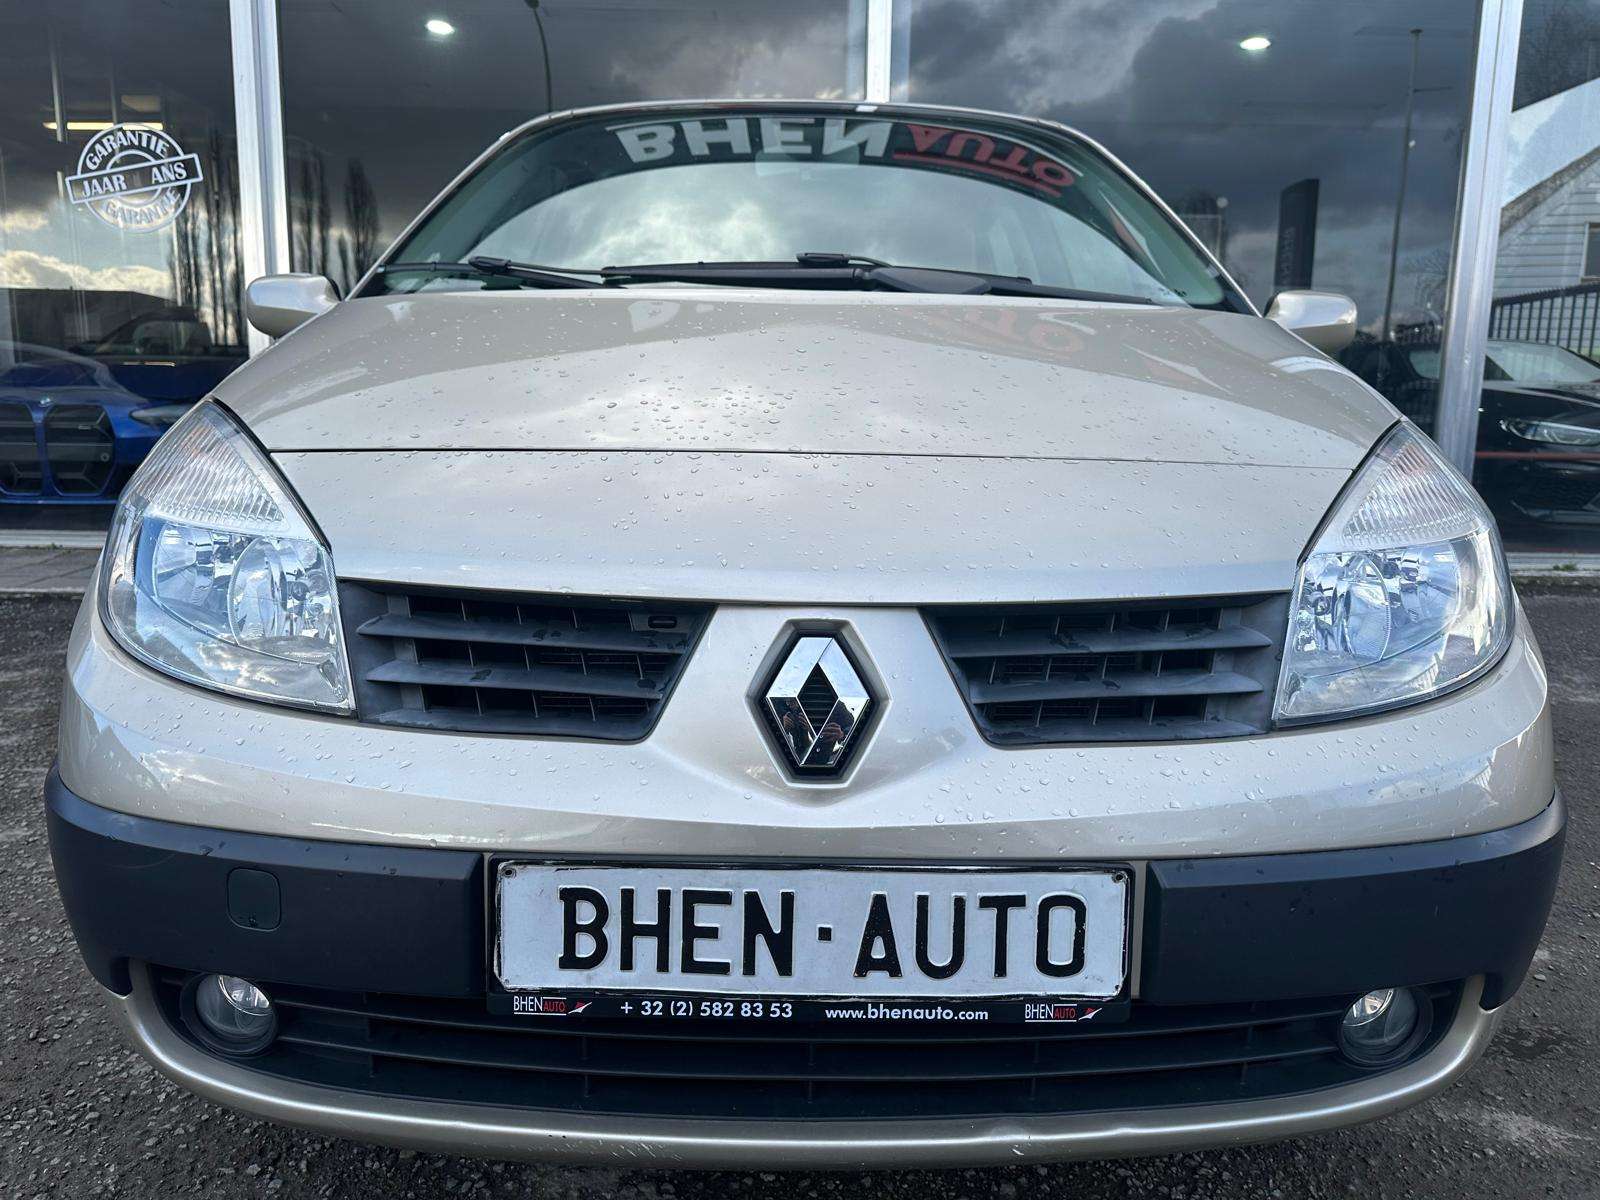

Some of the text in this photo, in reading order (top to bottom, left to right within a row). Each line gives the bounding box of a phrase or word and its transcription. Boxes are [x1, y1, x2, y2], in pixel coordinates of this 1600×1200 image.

[85, 130, 170, 171] GARANTIE
[82, 162, 187, 198] JAAR ANS
[558, 886, 795, 977] BHEN
[853, 891, 1087, 979] AUTO
[641, 1000, 663, 1016] 32
[670, 1000, 694, 1017] (2)
[700, 1001, 734, 1017] 582
[740, 1002, 762, 1018] 83
[769, 1002, 793, 1018] 53
[825, 1003, 989, 1021] www.bhenauto.com
